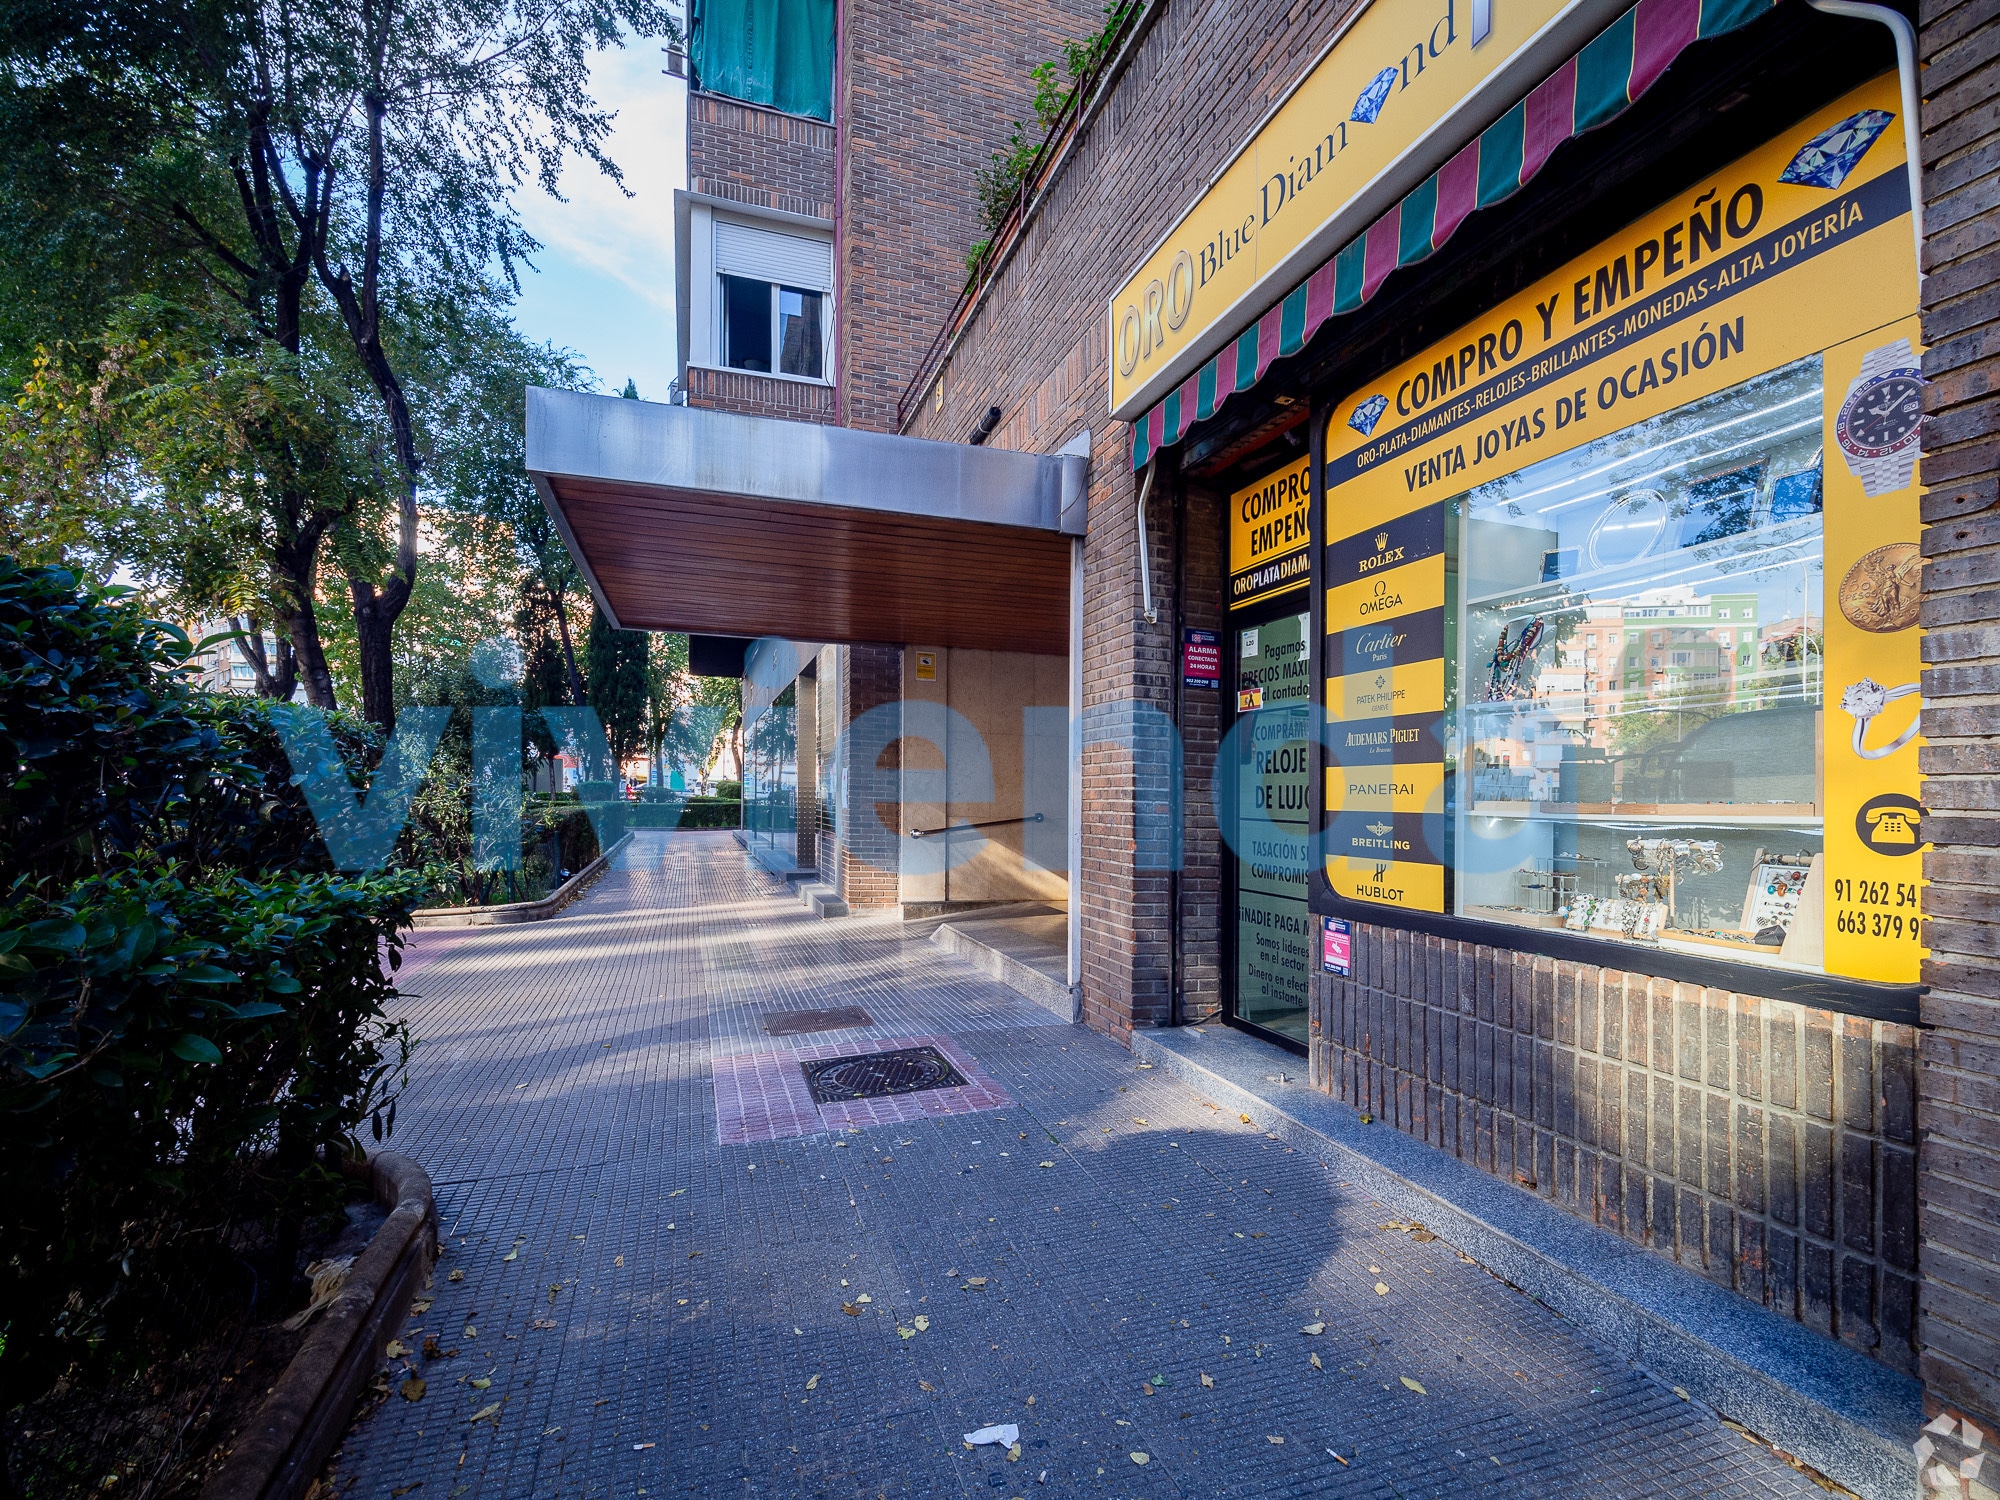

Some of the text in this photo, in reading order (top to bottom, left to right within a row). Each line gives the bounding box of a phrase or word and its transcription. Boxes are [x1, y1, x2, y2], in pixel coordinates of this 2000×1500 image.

[1769, 201, 1864, 266] JOYERÍA
[1117, 248, 1194, 379] ORO
[1198, 213, 1256, 289] Blue
[1396, 182, 1764, 417] COMPRO Y EMPEÑO
[1404, 316, 1744, 492] VENTA JOYAS DE OCASIÓN
[1242, 466, 1310, 523] COMPRO
[1251, 499, 1310, 557] EMPEÑ
[1358, 547, 1405, 573] ROLEX
[1359, 593, 1403, 615] OMEGA
[1188, 646, 1218, 655] ALARMA
[1264, 640, 1305, 661] Pagamos
[1355, 632, 1407, 655] Cartier
[1188, 655, 1218, 663] CONECTADA
[1197, 663, 1216, 671] HORAS
[1282, 656, 1310, 680] MÁXI
[1372, 653, 1388, 662] Paris
[1262, 680, 1309, 702] al contado
[1356, 689, 1406, 705] PATEK PHILIPPE
[1345, 728, 1420, 747] AUDEMARS PIGUET
[1256, 784, 1273, 809] DE
[1349, 783, 1415, 795] PANERAI
[1252, 838, 1297, 860] TASACIÓN
[1351, 837, 1411, 851] BREITLING
[1356, 884, 1405, 902] HUBLOT
[1834, 878, 1917, 908] 91 262 54
[1274, 913, 1300, 934] PAGA
[1837, 909, 1867, 936] 663
[1872, 913, 1903, 939] 379
[1256, 932, 1281, 951] Somos
[1282, 937, 1309, 959] líderes
[1260, 951, 1305, 972] en el sector
[1248, 963, 1273, 982] Dinero
[1275, 975, 1284, 986] en
[1261, 985, 1303, 1007] al instante
